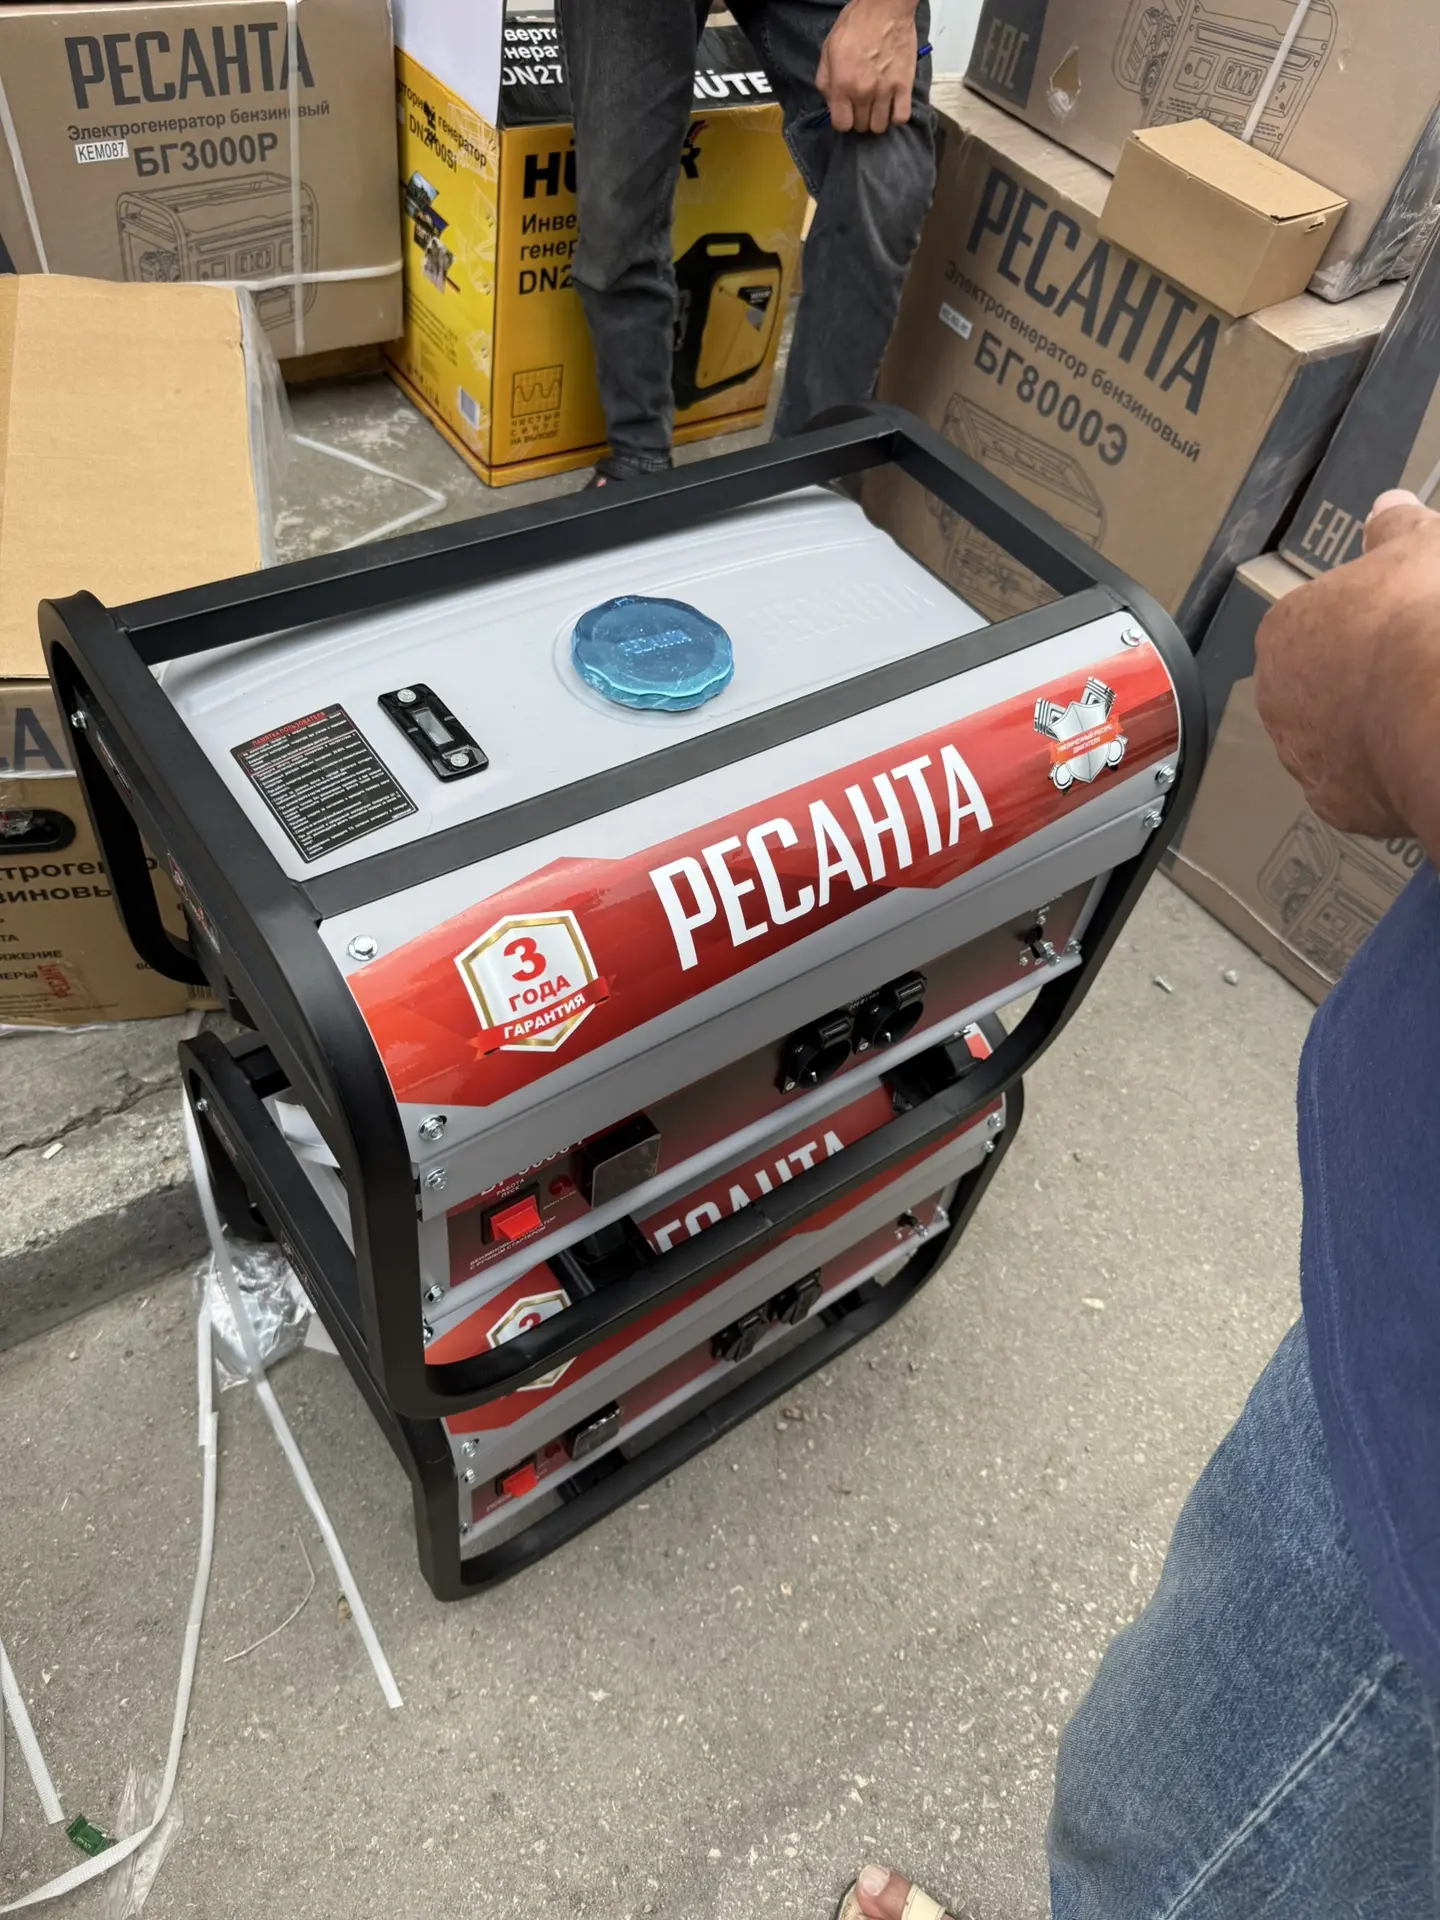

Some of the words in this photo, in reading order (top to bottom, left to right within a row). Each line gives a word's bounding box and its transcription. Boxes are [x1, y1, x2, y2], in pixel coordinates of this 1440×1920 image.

[65, 22, 315, 109] РЕСАНТА
[504, 45, 559, 62] нера
[67, 113, 226, 141] Электрогенератор
[229, 100, 330, 126] бензинвый
[438, 116, 487, 168] генератор
[77, 141, 126, 161] KEM087
[134, 132, 279, 177] БГ3000Р
[965, 167, 1222, 417] РЕСАНТА
[944, 260, 1088, 379] Электрогенератор
[1091, 367, 1202, 463] бензиновый
[973, 329, 1128, 467] БГ8000Э
[649, 744, 993, 971] РЕСАНТА
[503, 936, 548, 983] 3
[503, 993, 586, 1040] ГАРАНТИЯ
[508, 974, 572, 1013] ГОДА
[496, 1178, 525, 1196] РАБОТА
[500, 1186, 521, 1198] ПУСК
